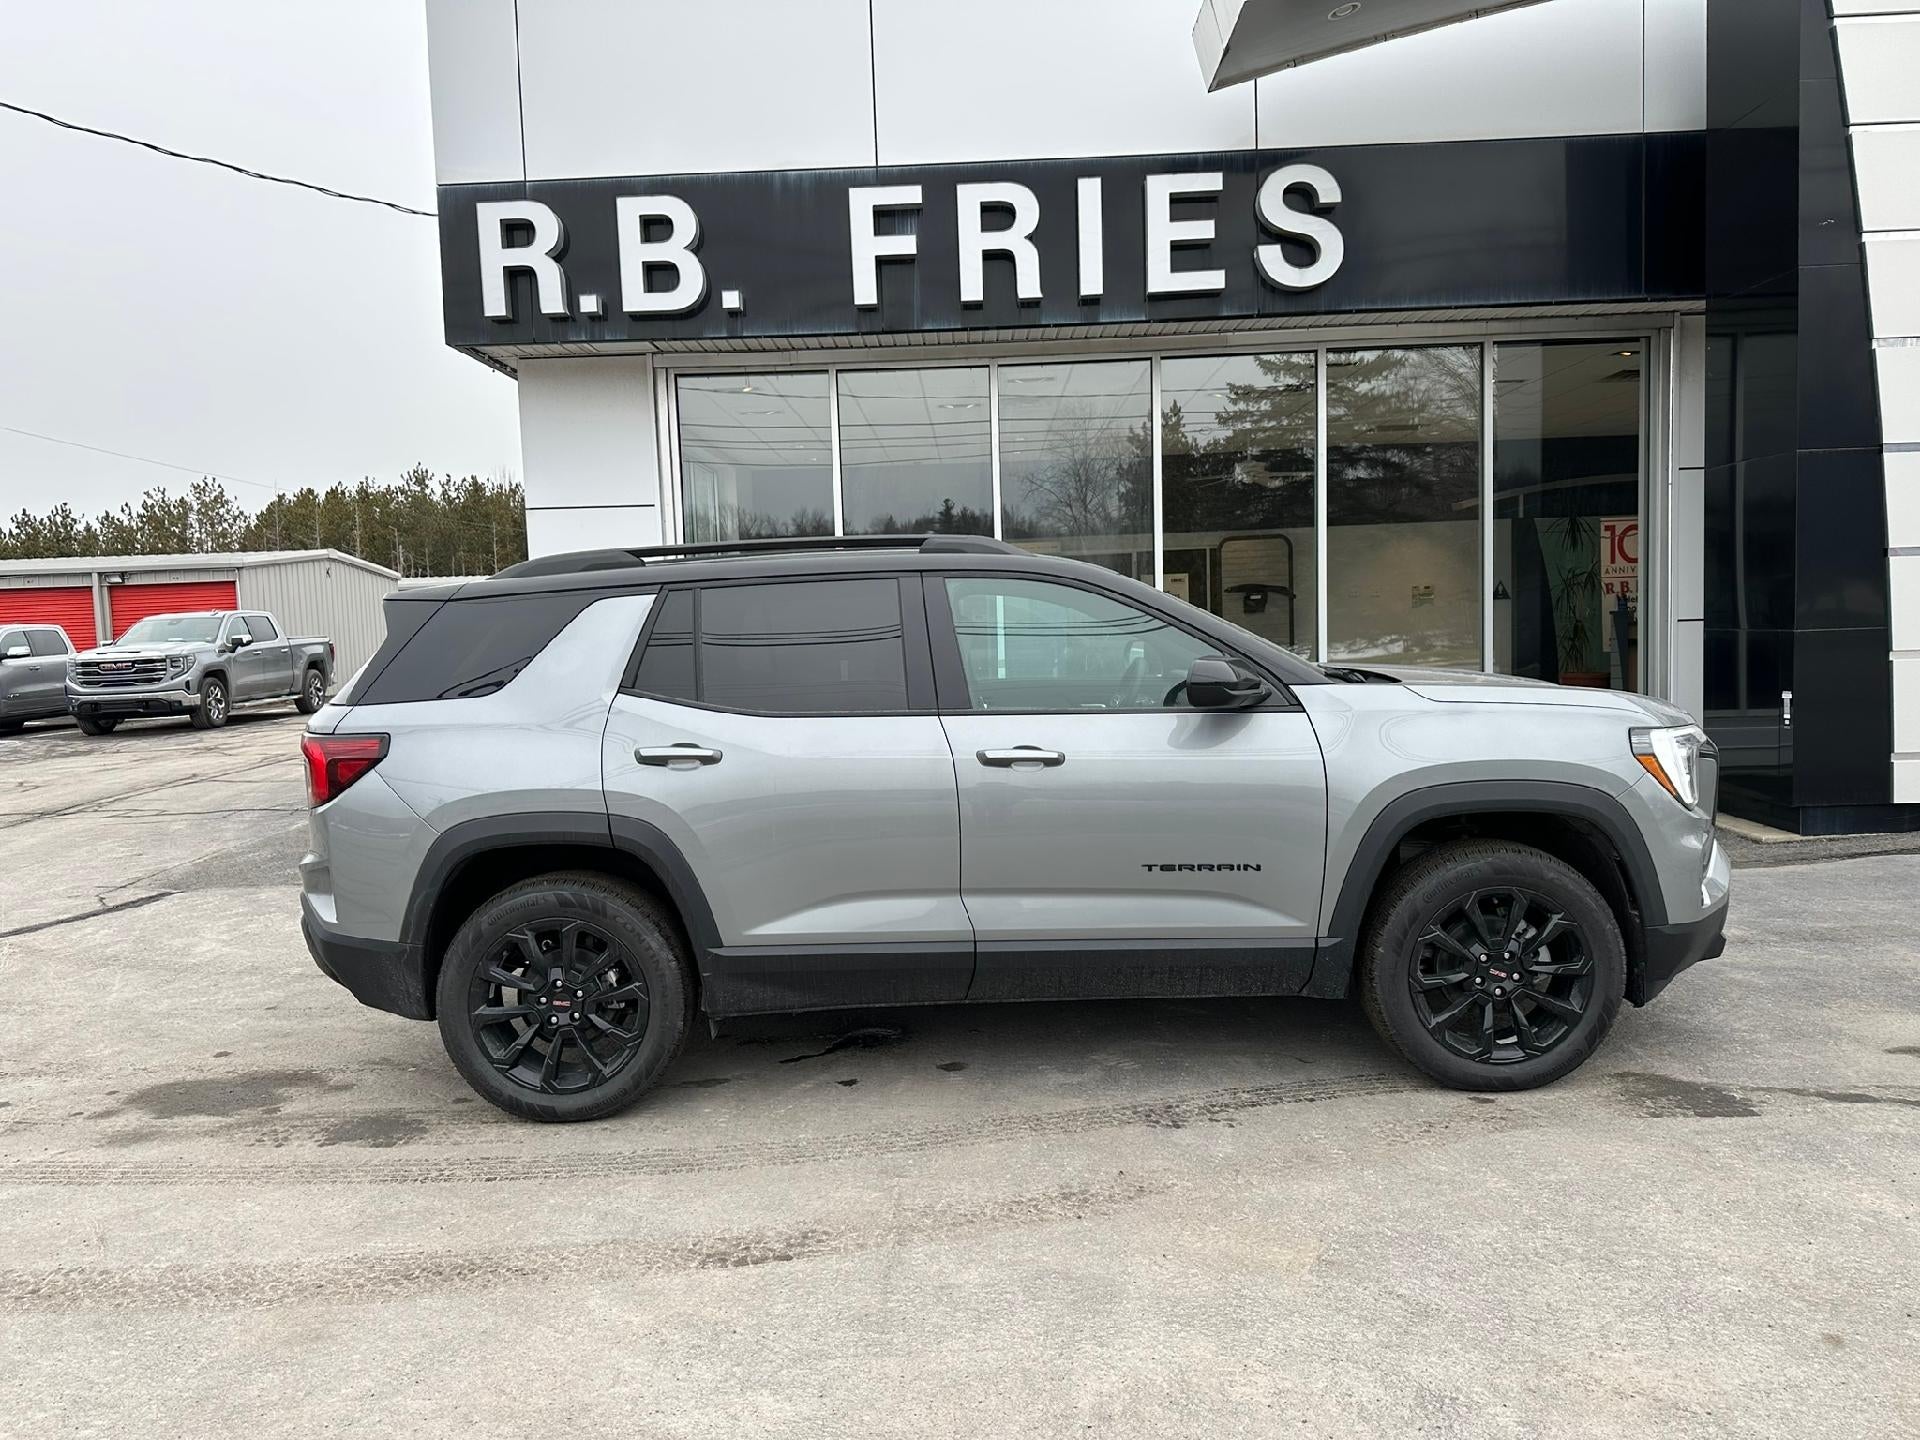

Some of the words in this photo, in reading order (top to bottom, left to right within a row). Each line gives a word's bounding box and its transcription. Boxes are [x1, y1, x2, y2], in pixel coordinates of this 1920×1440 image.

[476, 194, 744, 320] R.B.
[848, 163, 1346, 308] FRIES
[99, 662, 132, 671] GMC
[1141, 864, 1262, 872] TERRAIN
